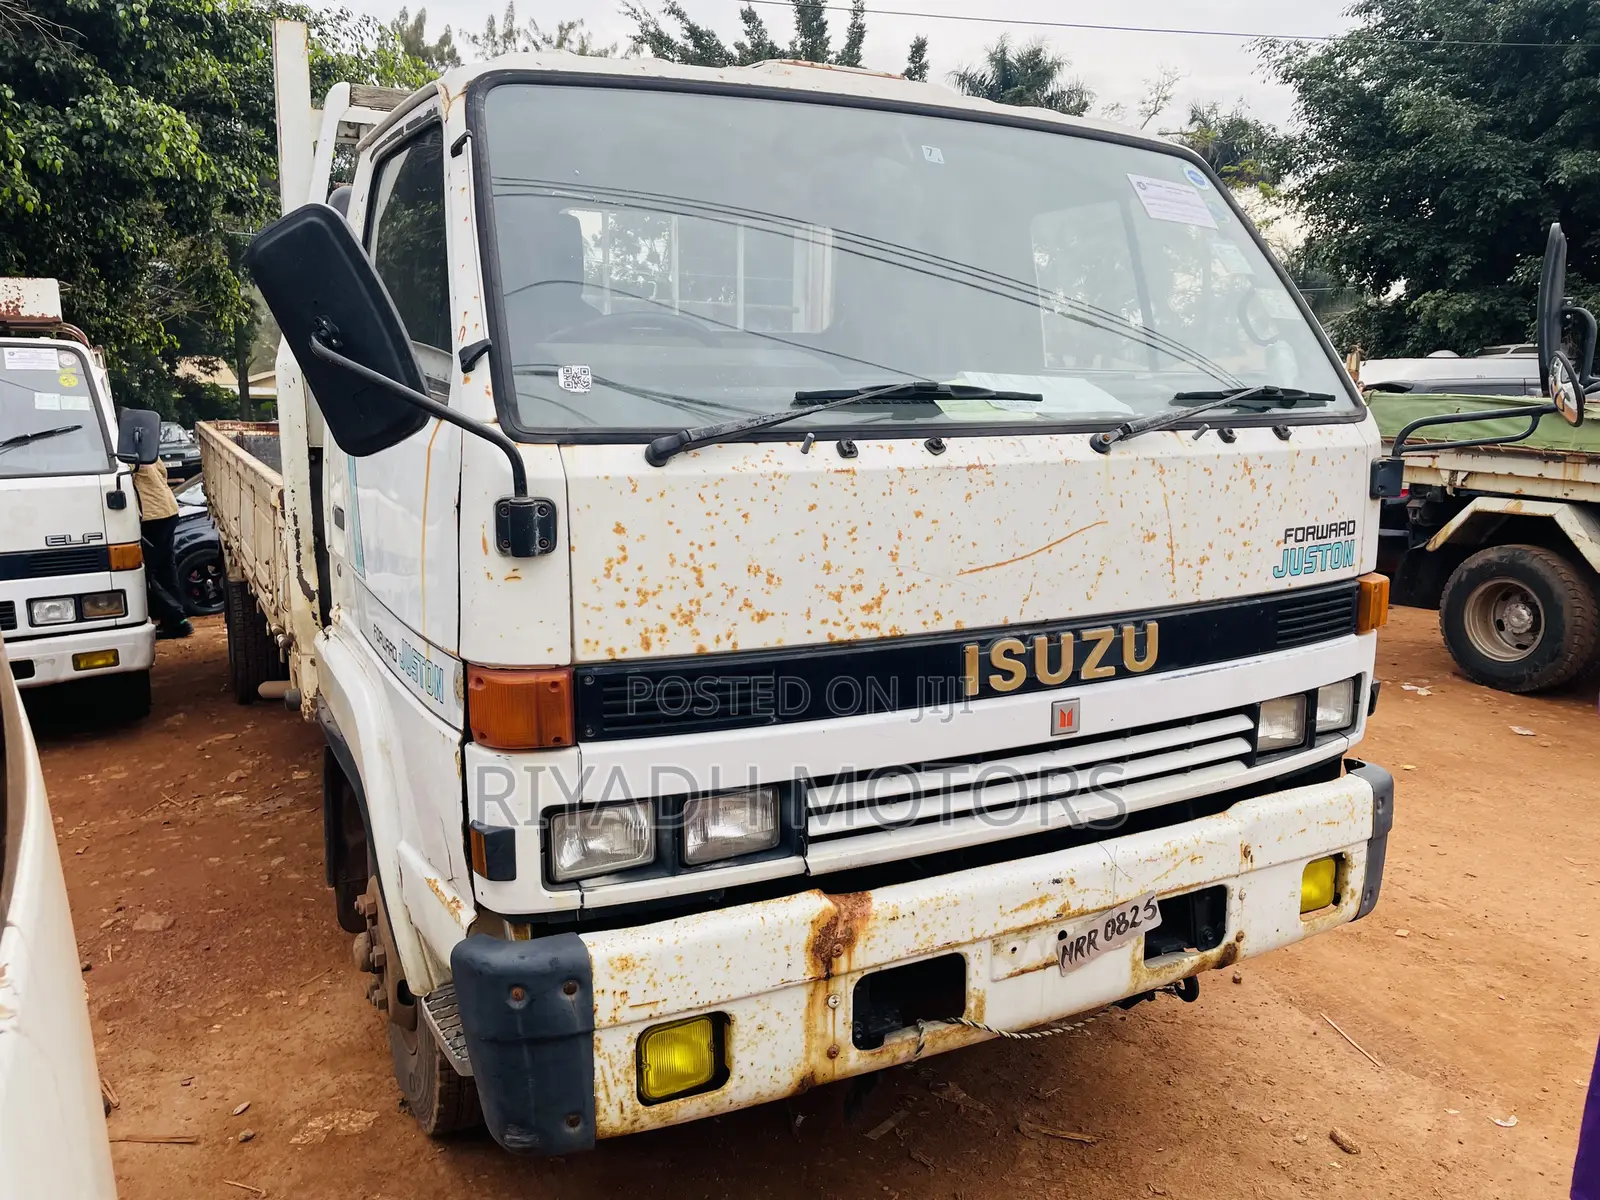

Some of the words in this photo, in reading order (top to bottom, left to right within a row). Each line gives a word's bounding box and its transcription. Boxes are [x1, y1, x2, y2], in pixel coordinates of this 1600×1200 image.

[45, 532, 103, 547] ELF
[1284, 520, 1356, 544] FORWARD
[1272, 539, 1355, 578] JUSTON
[399, 637, 444, 704] JUSTON
[964, 621, 1160, 696] ISUZU
[1103, 895, 1158, 942] 0825
